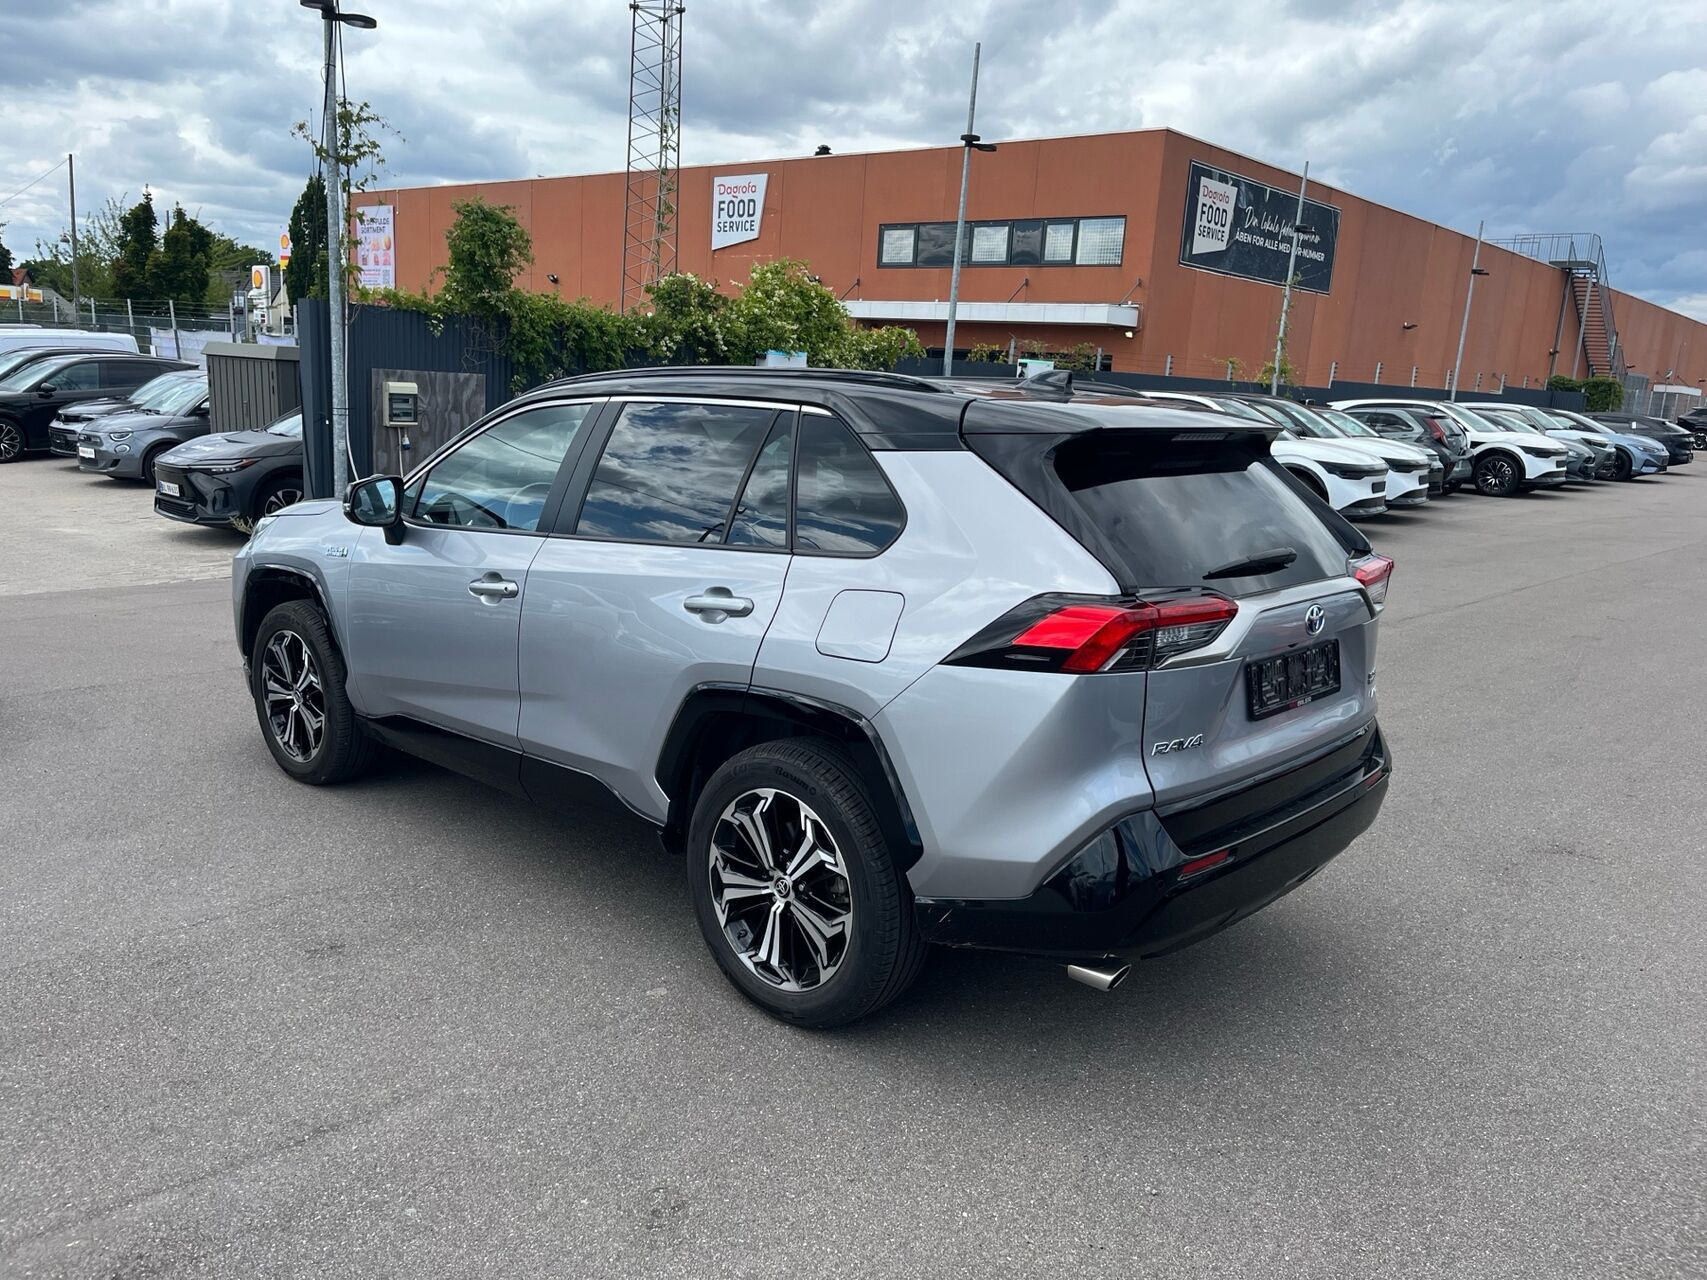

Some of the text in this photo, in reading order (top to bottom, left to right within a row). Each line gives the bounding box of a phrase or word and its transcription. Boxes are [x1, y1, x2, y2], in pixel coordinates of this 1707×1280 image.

[717, 181, 757, 198] Dagrofa
[717, 198, 756, 219] FOOD
[1200, 203, 1228, 228] FOOD
[717, 220, 755, 232] SERVICE
[1198, 225, 1225, 243] SERVICE
[1235, 228, 1252, 243] ÅBEN
[1252, 235, 1264, 247] FOR
[1264, 239, 1278, 250] ALLE
[1278, 242, 1291, 254] MED
[1151, 733, 1204, 756] RAV4
